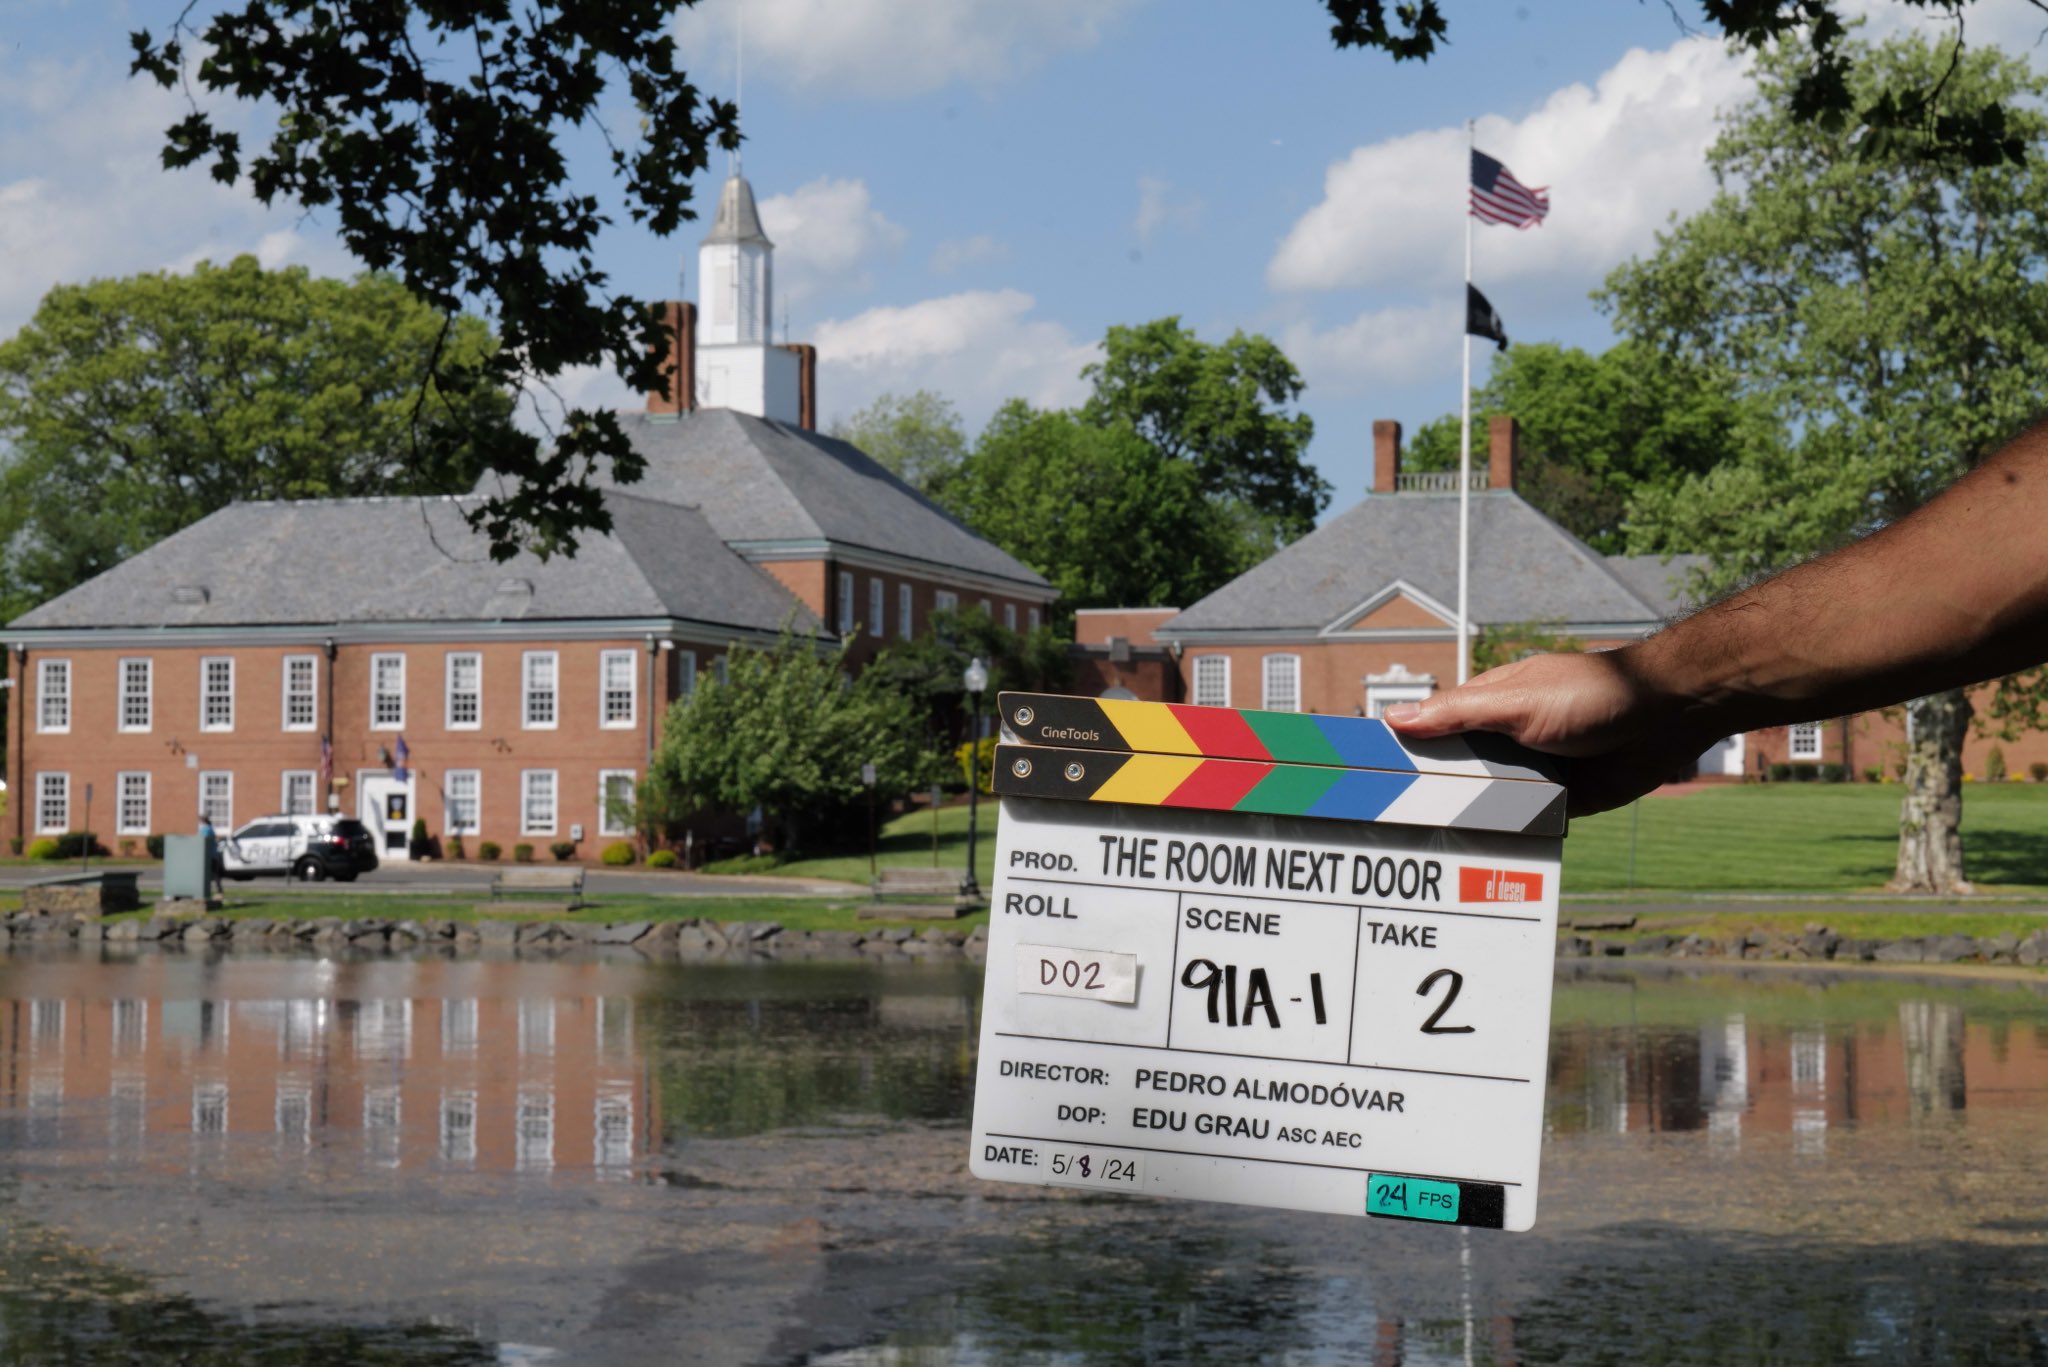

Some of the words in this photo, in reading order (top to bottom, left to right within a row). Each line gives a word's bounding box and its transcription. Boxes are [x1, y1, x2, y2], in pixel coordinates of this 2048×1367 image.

[1041, 726, 1100, 741] CineTools
[1010, 850, 1078, 872] PROD.
[1099, 834, 1158, 879] THE
[1165, 840, 1257, 887] ROOM
[1265, 847, 1345, 894] NEXT
[1351, 854, 1442, 902] DOOR
[1004, 892, 1078, 919] ROLL
[1185, 907, 1281, 936] SCENE
[1367, 921, 1437, 948] TAKE
[1415, 968, 1476, 1034] 2
[1000, 1060, 1110, 1086] DIRECTOR:
[1135, 1068, 1226, 1096] PEDRO
[1233, 1077, 1405, 1113] ALMODÓVAR
[1057, 1104, 1107, 1124] DOP:
[1132, 1107, 1186, 1131] EDU
[1194, 1113, 1270, 1140] GRAU
[1276, 1126, 1317, 1145] ASC
[1321, 1130, 1362, 1149] AEC
[984, 1145, 1038, 1166] DATE:
[1418, 1192, 1453, 1209] FPS
